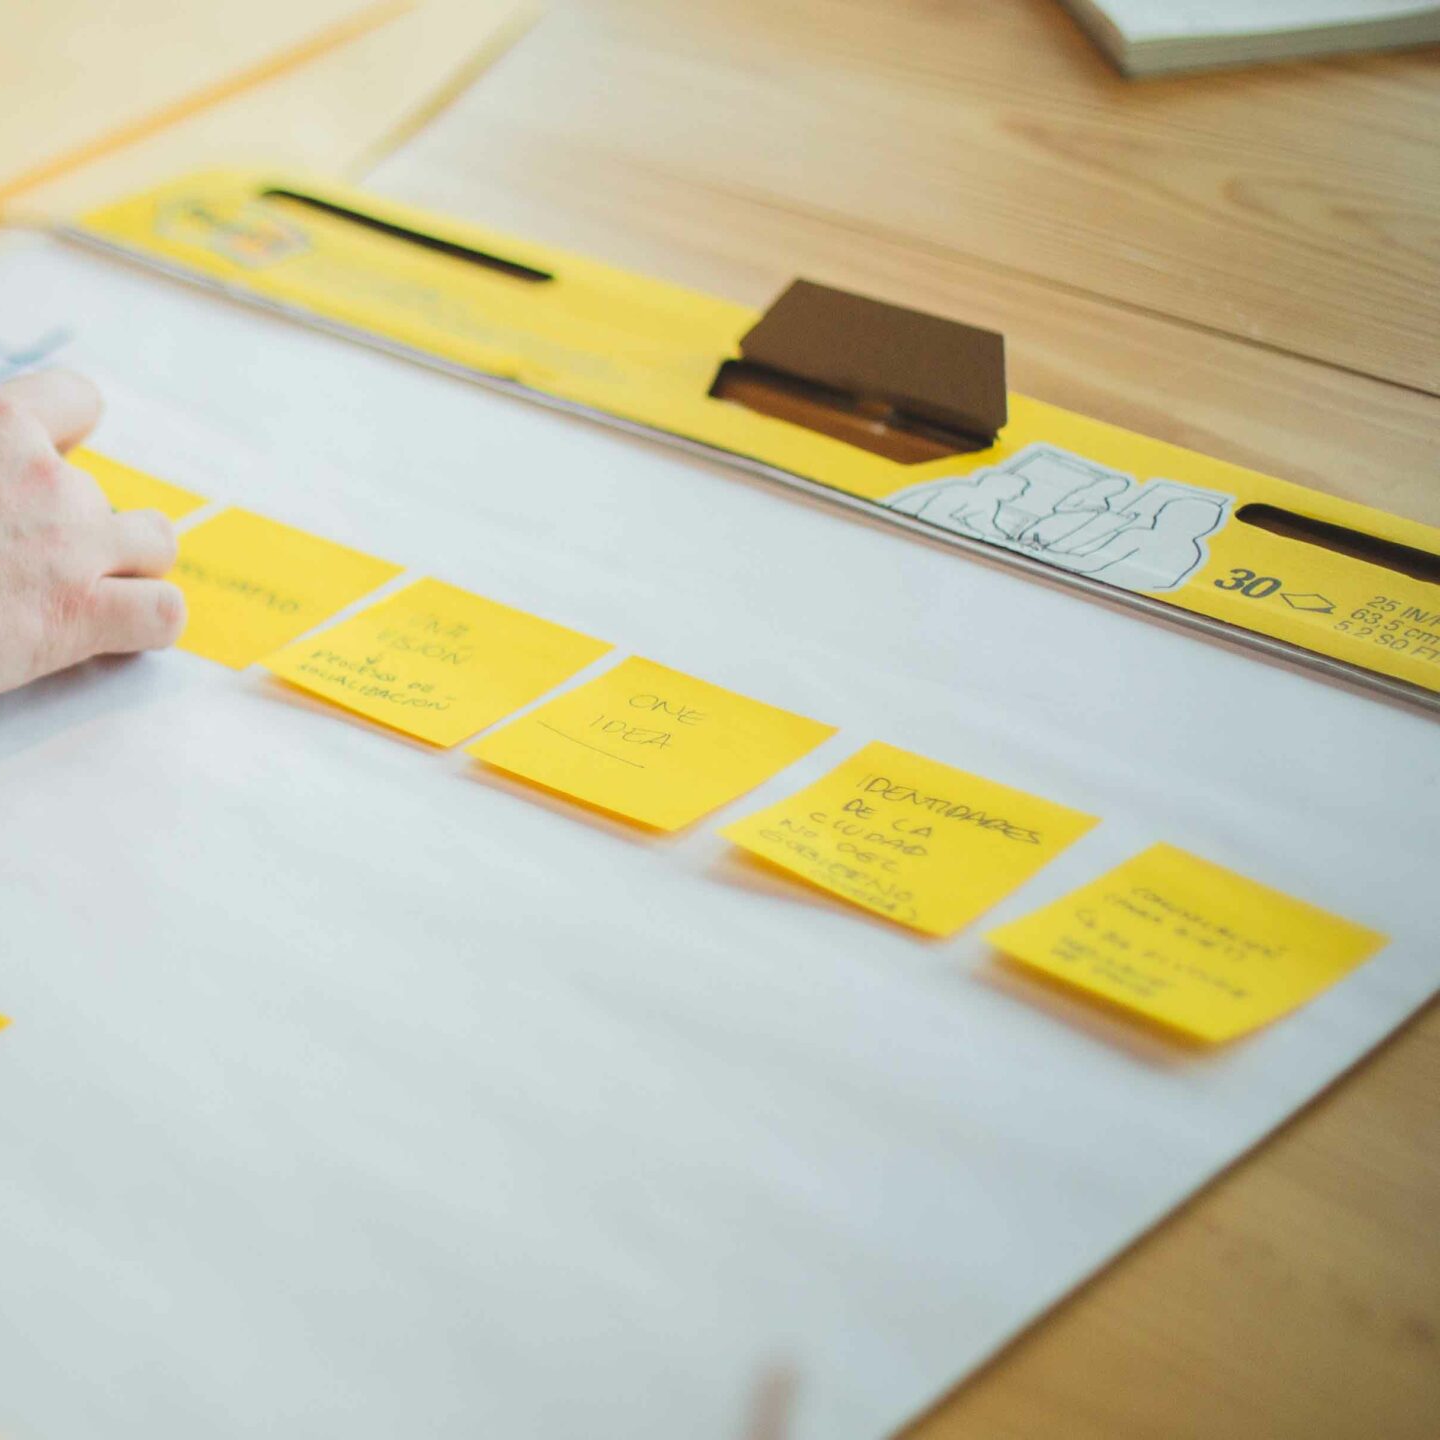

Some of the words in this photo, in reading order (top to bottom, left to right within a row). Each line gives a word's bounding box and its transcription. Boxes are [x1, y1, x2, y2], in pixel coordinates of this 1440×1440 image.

[1214, 568, 1282, 599] 30
[1366, 595, 1402, 612] 25
[628, 694, 707, 726] ONE
[589, 714, 672, 749] IDEA
[842, 798, 880, 820] DE
[856, 774, 1042, 845] IDENTIDADES
[809, 811, 928, 857] CIUDAD
